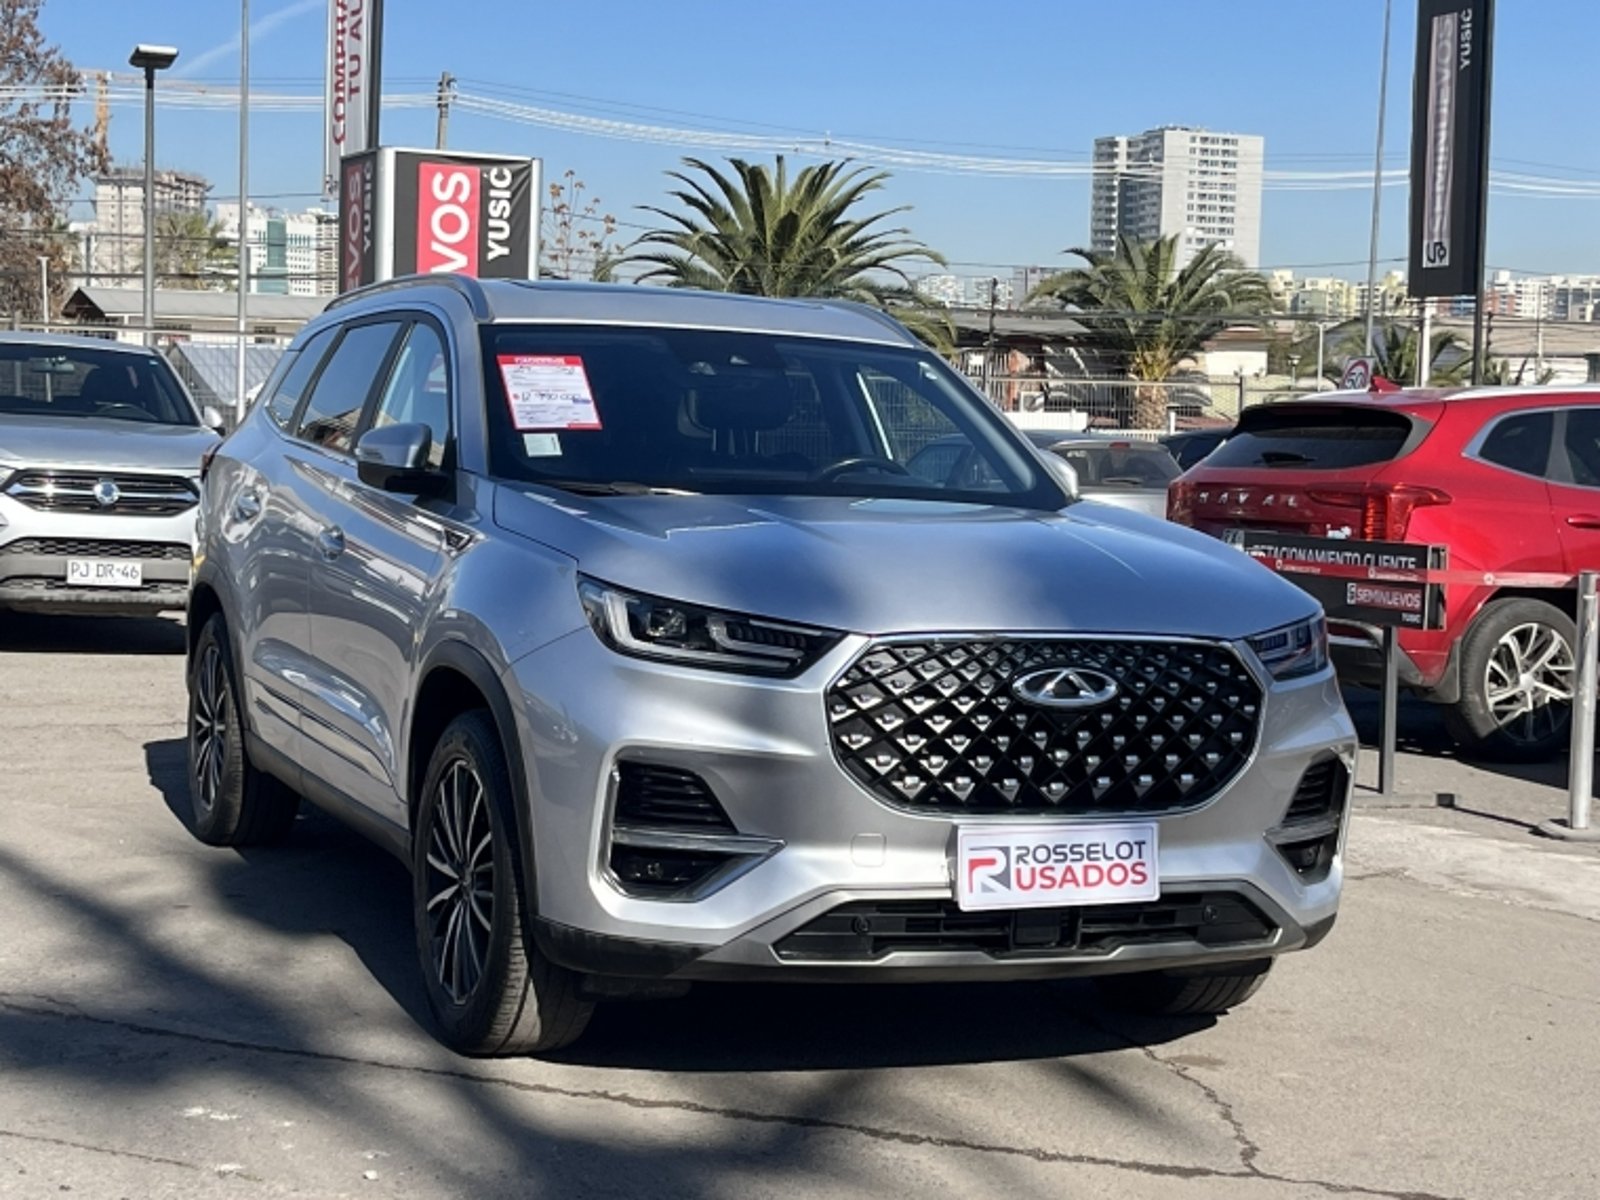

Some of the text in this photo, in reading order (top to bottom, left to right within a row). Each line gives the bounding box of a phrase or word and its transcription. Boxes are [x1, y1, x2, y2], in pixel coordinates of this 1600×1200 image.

[348, 54, 362, 102] TU
[430, 171, 471, 274] VOS
[1015, 840, 1147, 865] ROSSELOT
[1015, 862, 1148, 891] USADOS
